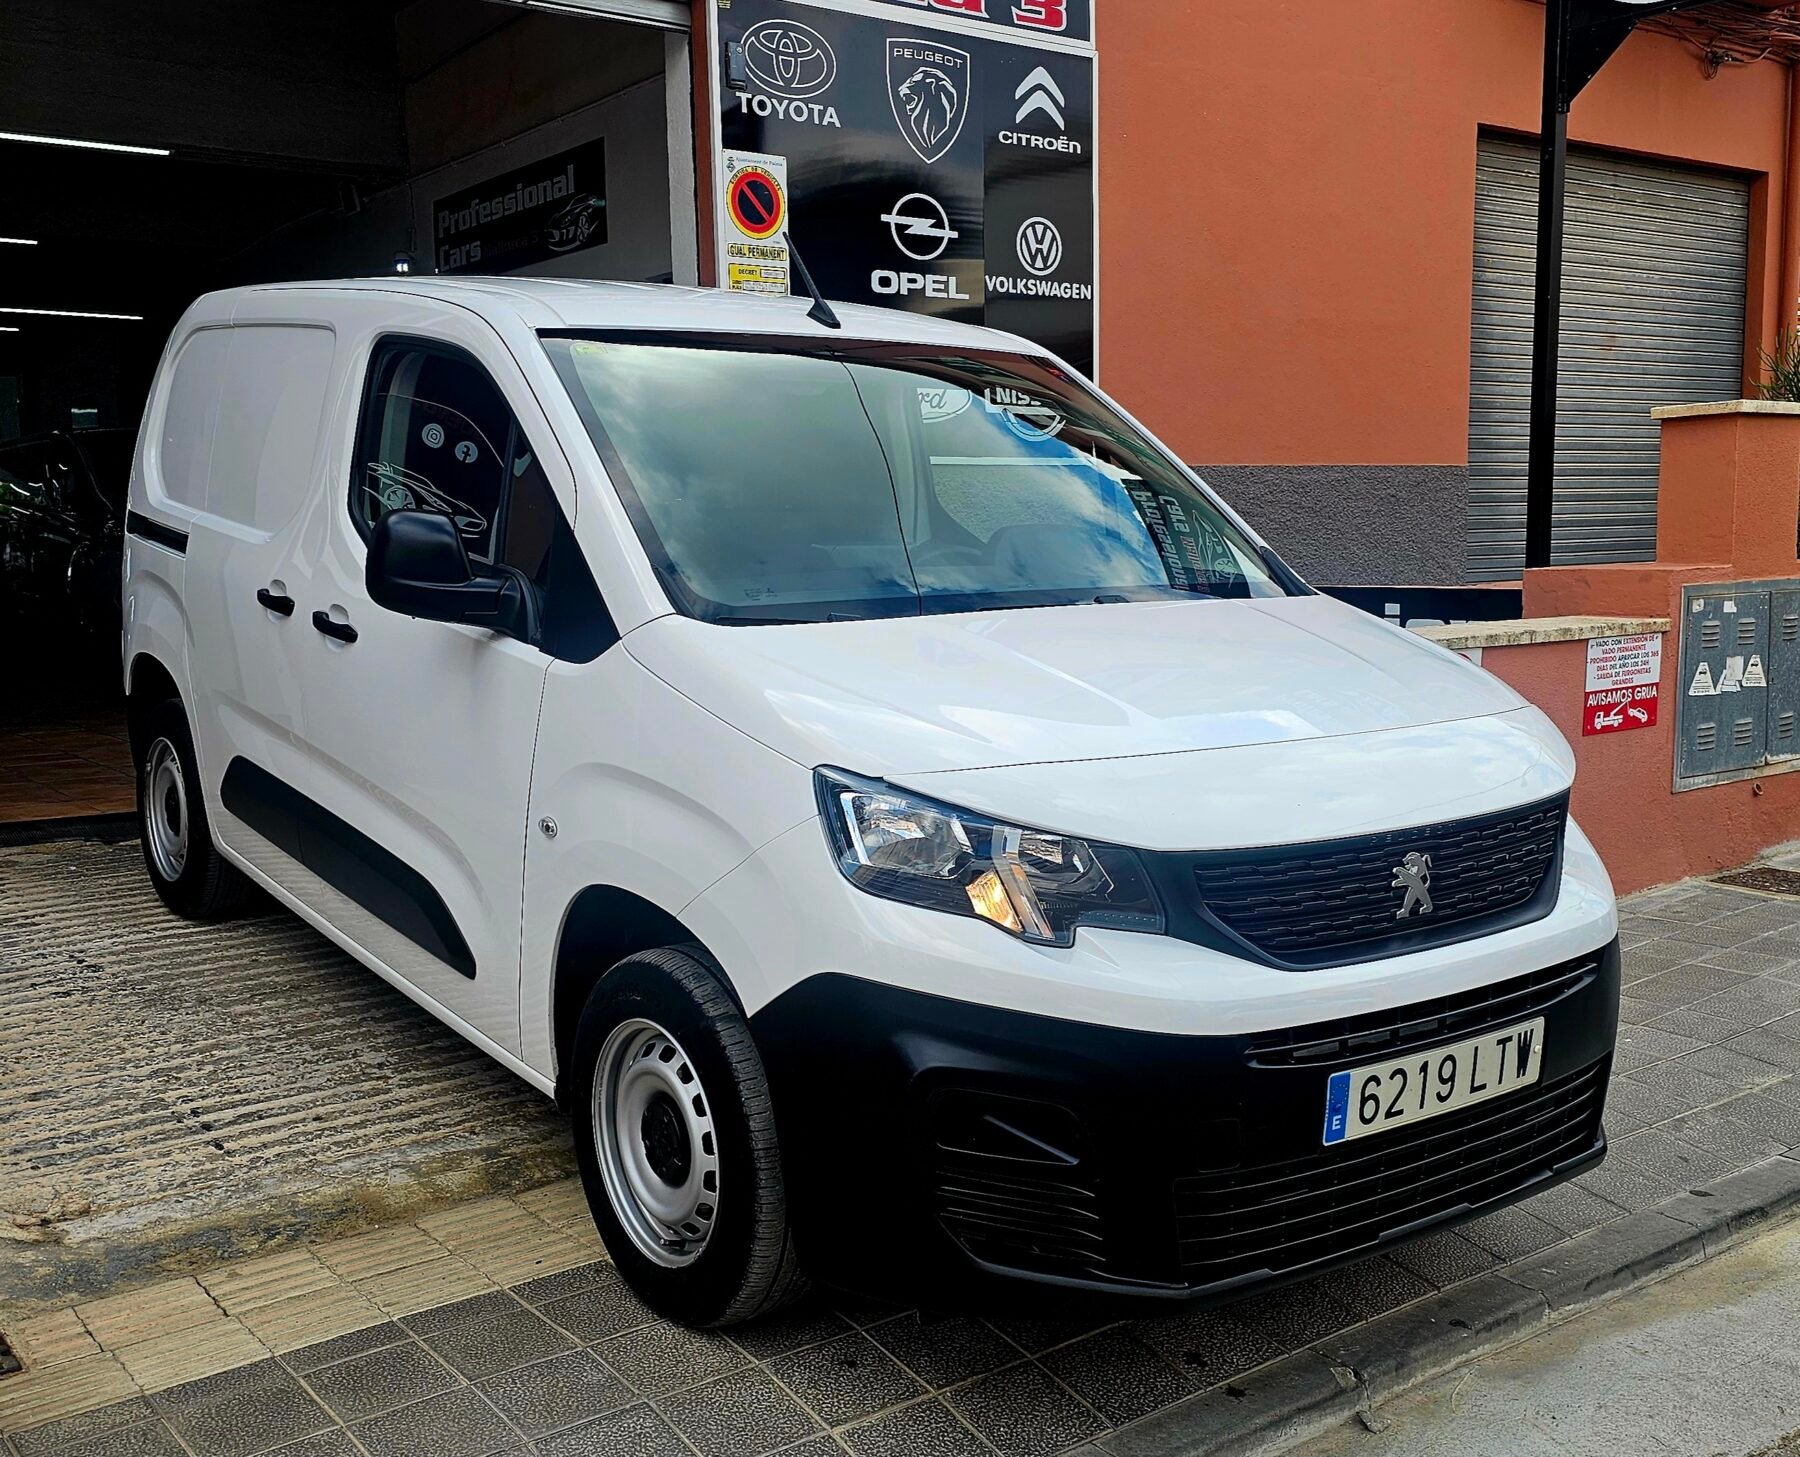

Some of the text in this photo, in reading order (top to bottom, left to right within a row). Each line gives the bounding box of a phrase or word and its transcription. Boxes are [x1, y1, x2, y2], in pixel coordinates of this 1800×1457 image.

[893, 48, 964, 69] PEUGEOT
[735, 91, 841, 128] TOYOTA
[437, 164, 576, 238] Professional
[439, 240, 482, 272] Cars
[730, 245, 784, 260] GUAL PERMANENT
[871, 269, 970, 300] OPEL
[985, 275, 1092, 300] VOLKSWAGEN
[1602, 644, 1646, 655] VADO PERMANENTE
[1611, 638, 1622, 646] CON
[1612, 677, 1634, 686] GRANDES
[1587, 685, 1657, 707] AVISAMOS GRUA
[1358, 1028, 1535, 1126] 6219 LTW
[1332, 1114, 1342, 1131] E
